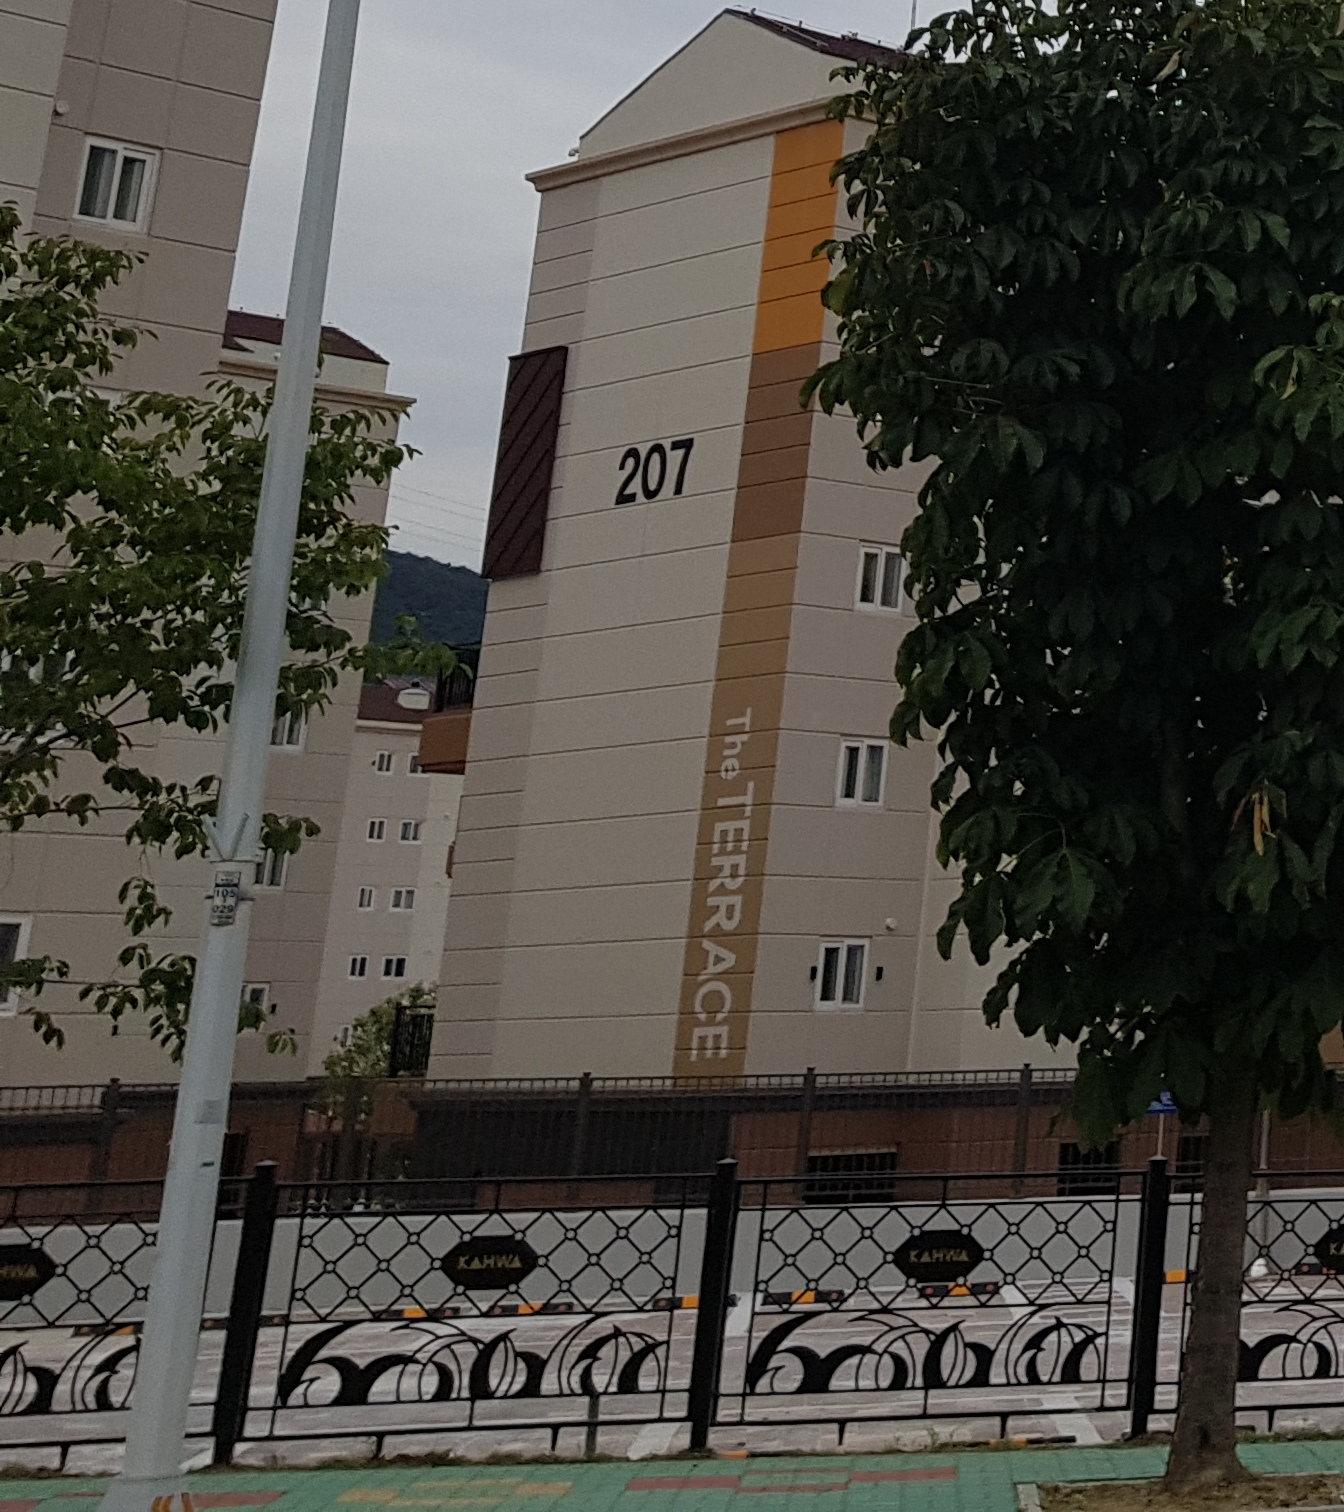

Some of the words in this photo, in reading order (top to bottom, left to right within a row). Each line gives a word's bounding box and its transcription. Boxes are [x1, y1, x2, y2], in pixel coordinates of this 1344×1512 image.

[614, 437, 694, 506] 207
[720, 707, 752, 780] The
[689, 780, 755, 1062] TERRACE
[457, 1254, 523, 1270] KAHWA
[909, 1249, 969, 1263] KAHWA
